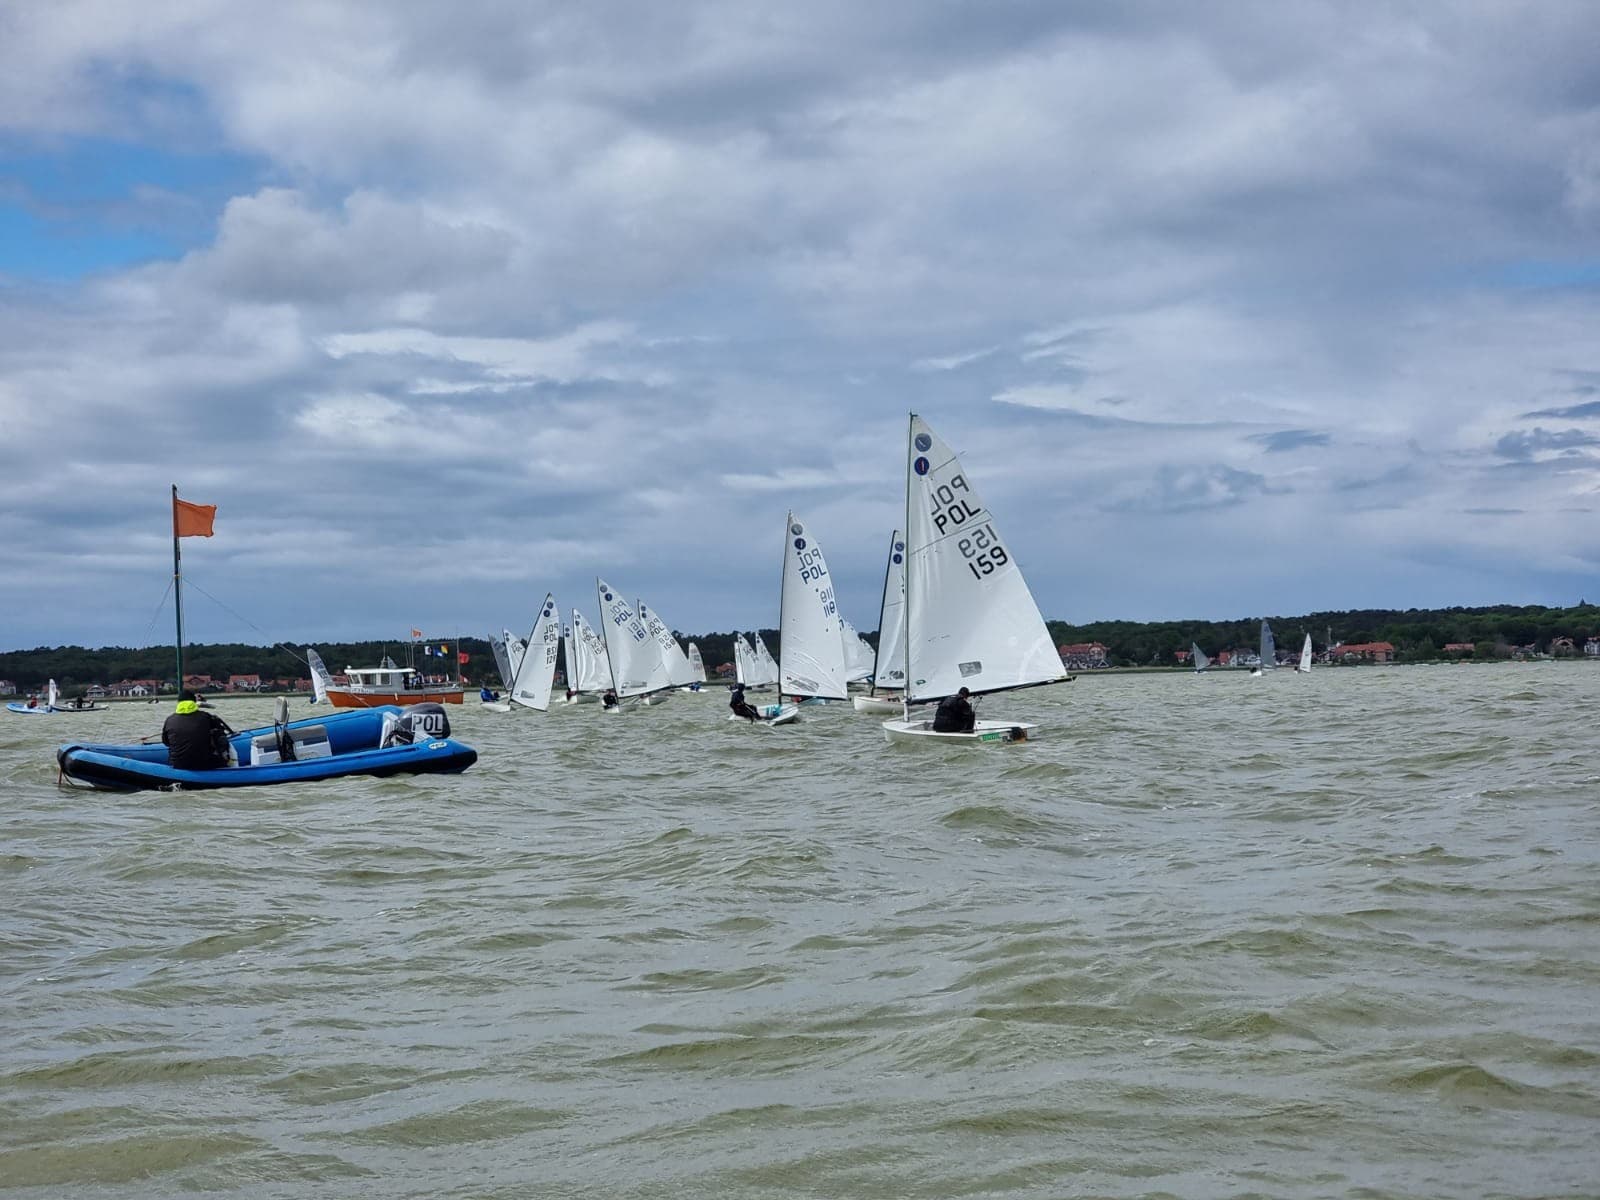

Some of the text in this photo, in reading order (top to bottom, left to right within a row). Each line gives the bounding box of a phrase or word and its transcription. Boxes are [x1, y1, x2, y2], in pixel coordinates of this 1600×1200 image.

[934, 500, 981, 535] POL
[968, 546, 1008, 580] 159
[801, 564, 827, 584] POL
[614, 610, 633, 626] POL
[633, 627, 647, 642] 161
[650, 625, 665, 638] POL
[412, 715, 442, 732] POL
